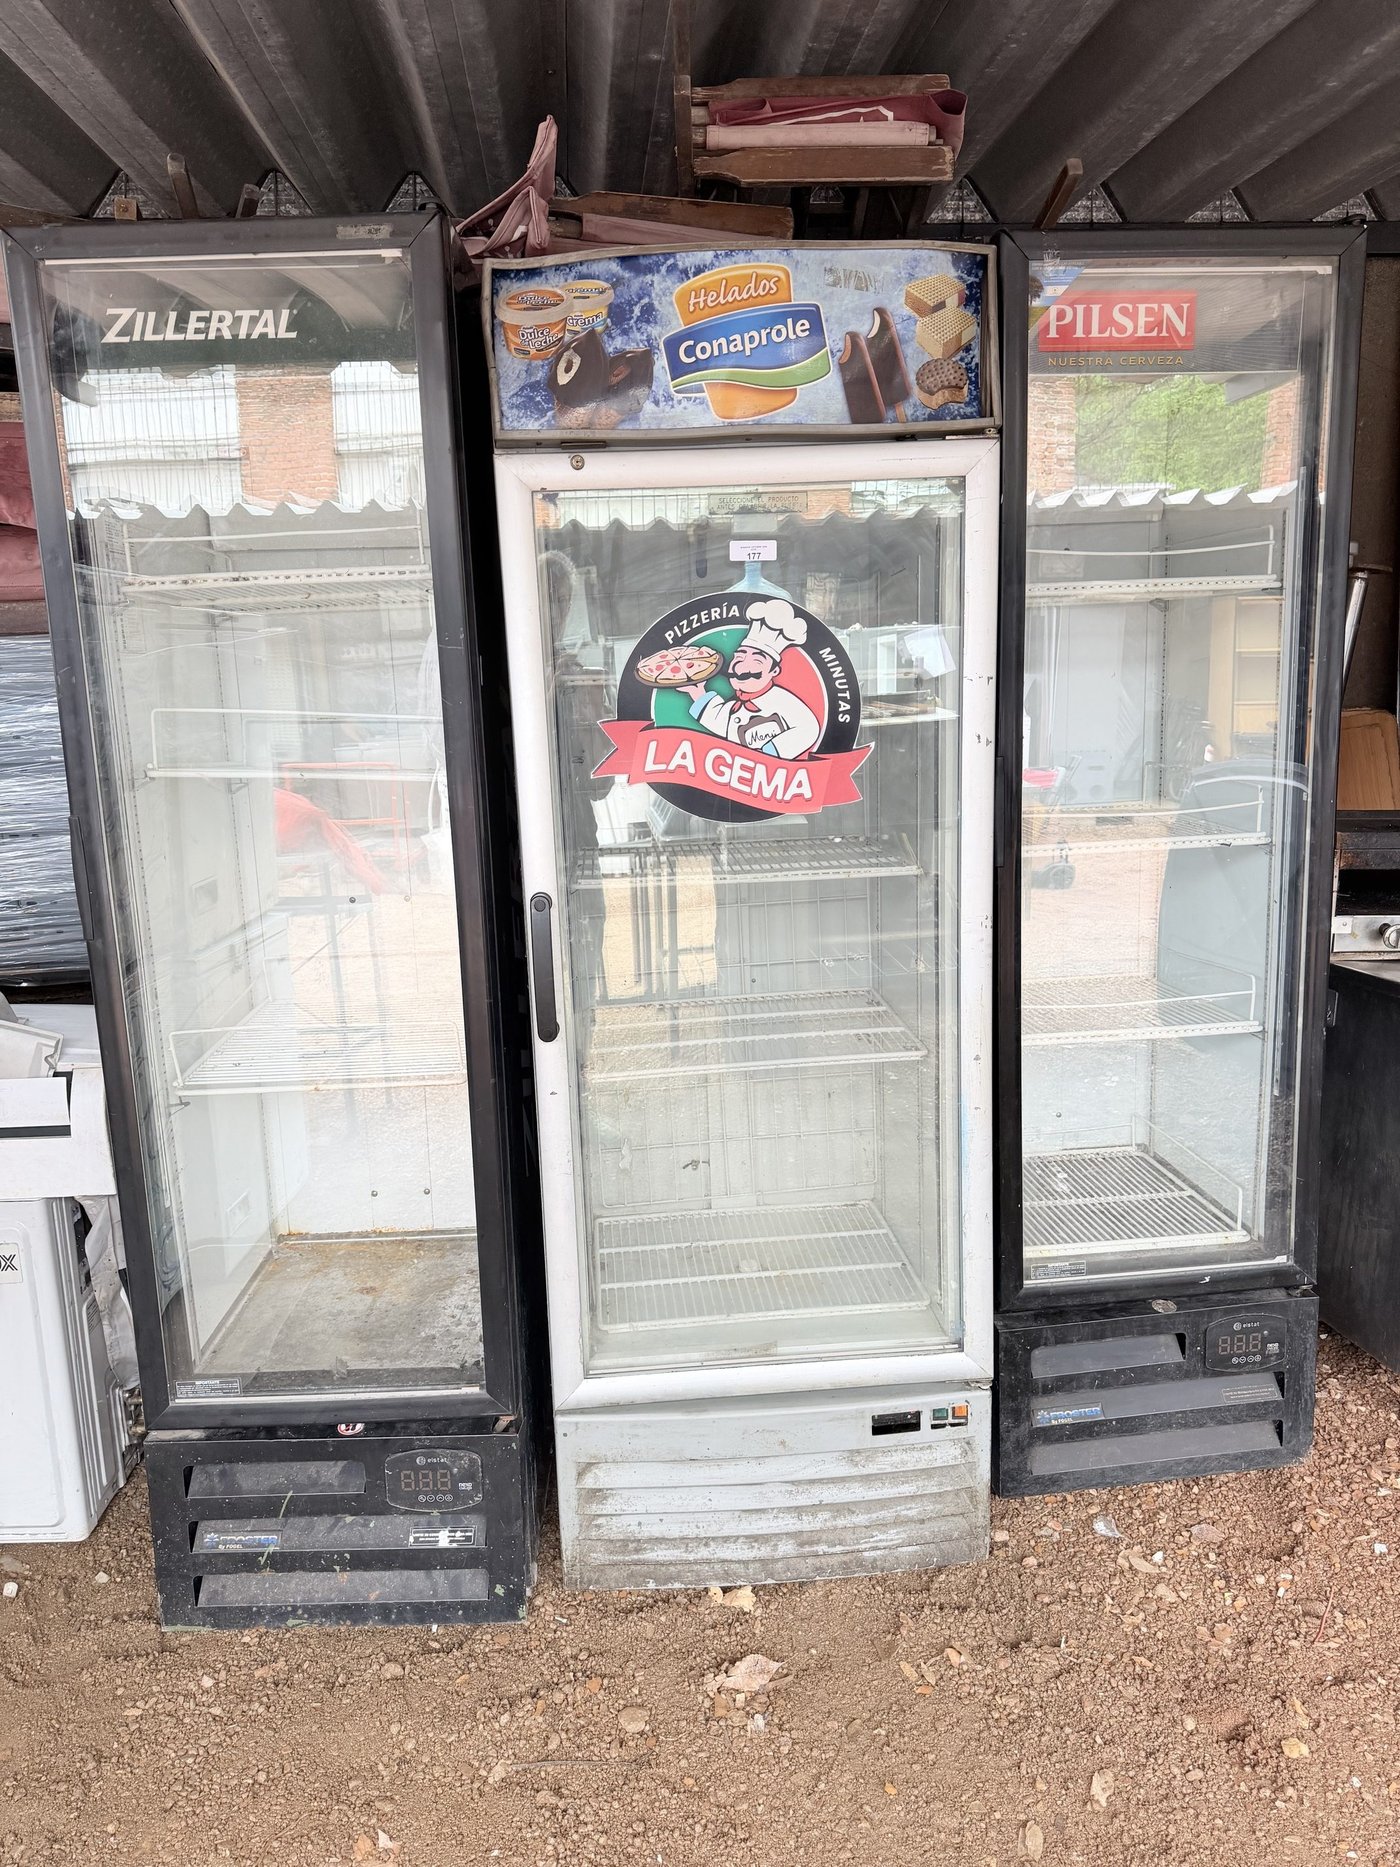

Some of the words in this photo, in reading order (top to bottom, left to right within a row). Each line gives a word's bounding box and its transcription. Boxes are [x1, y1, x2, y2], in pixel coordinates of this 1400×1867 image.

[688, 273, 780, 311] Helados
[101, 307, 298, 344] ZILLERTAL
[518, 327, 550, 341] Dulce
[566, 311, 604, 327] Crema
[1046, 302, 1191, 339] PILSEN
[529, 333, 559, 349] Leche
[678, 316, 811, 364] Conaprole
[1048, 356, 1113, 367] NUESTRA
[1120, 355, 1185, 366] CERVEZA
[747, 552, 761, 560] 177
[664, 602, 740, 645] PIZZERÍA
[818, 646, 851, 724] MINUTAS
[644, 739, 697, 777] LA
[703, 747, 813, 803] GEMA
